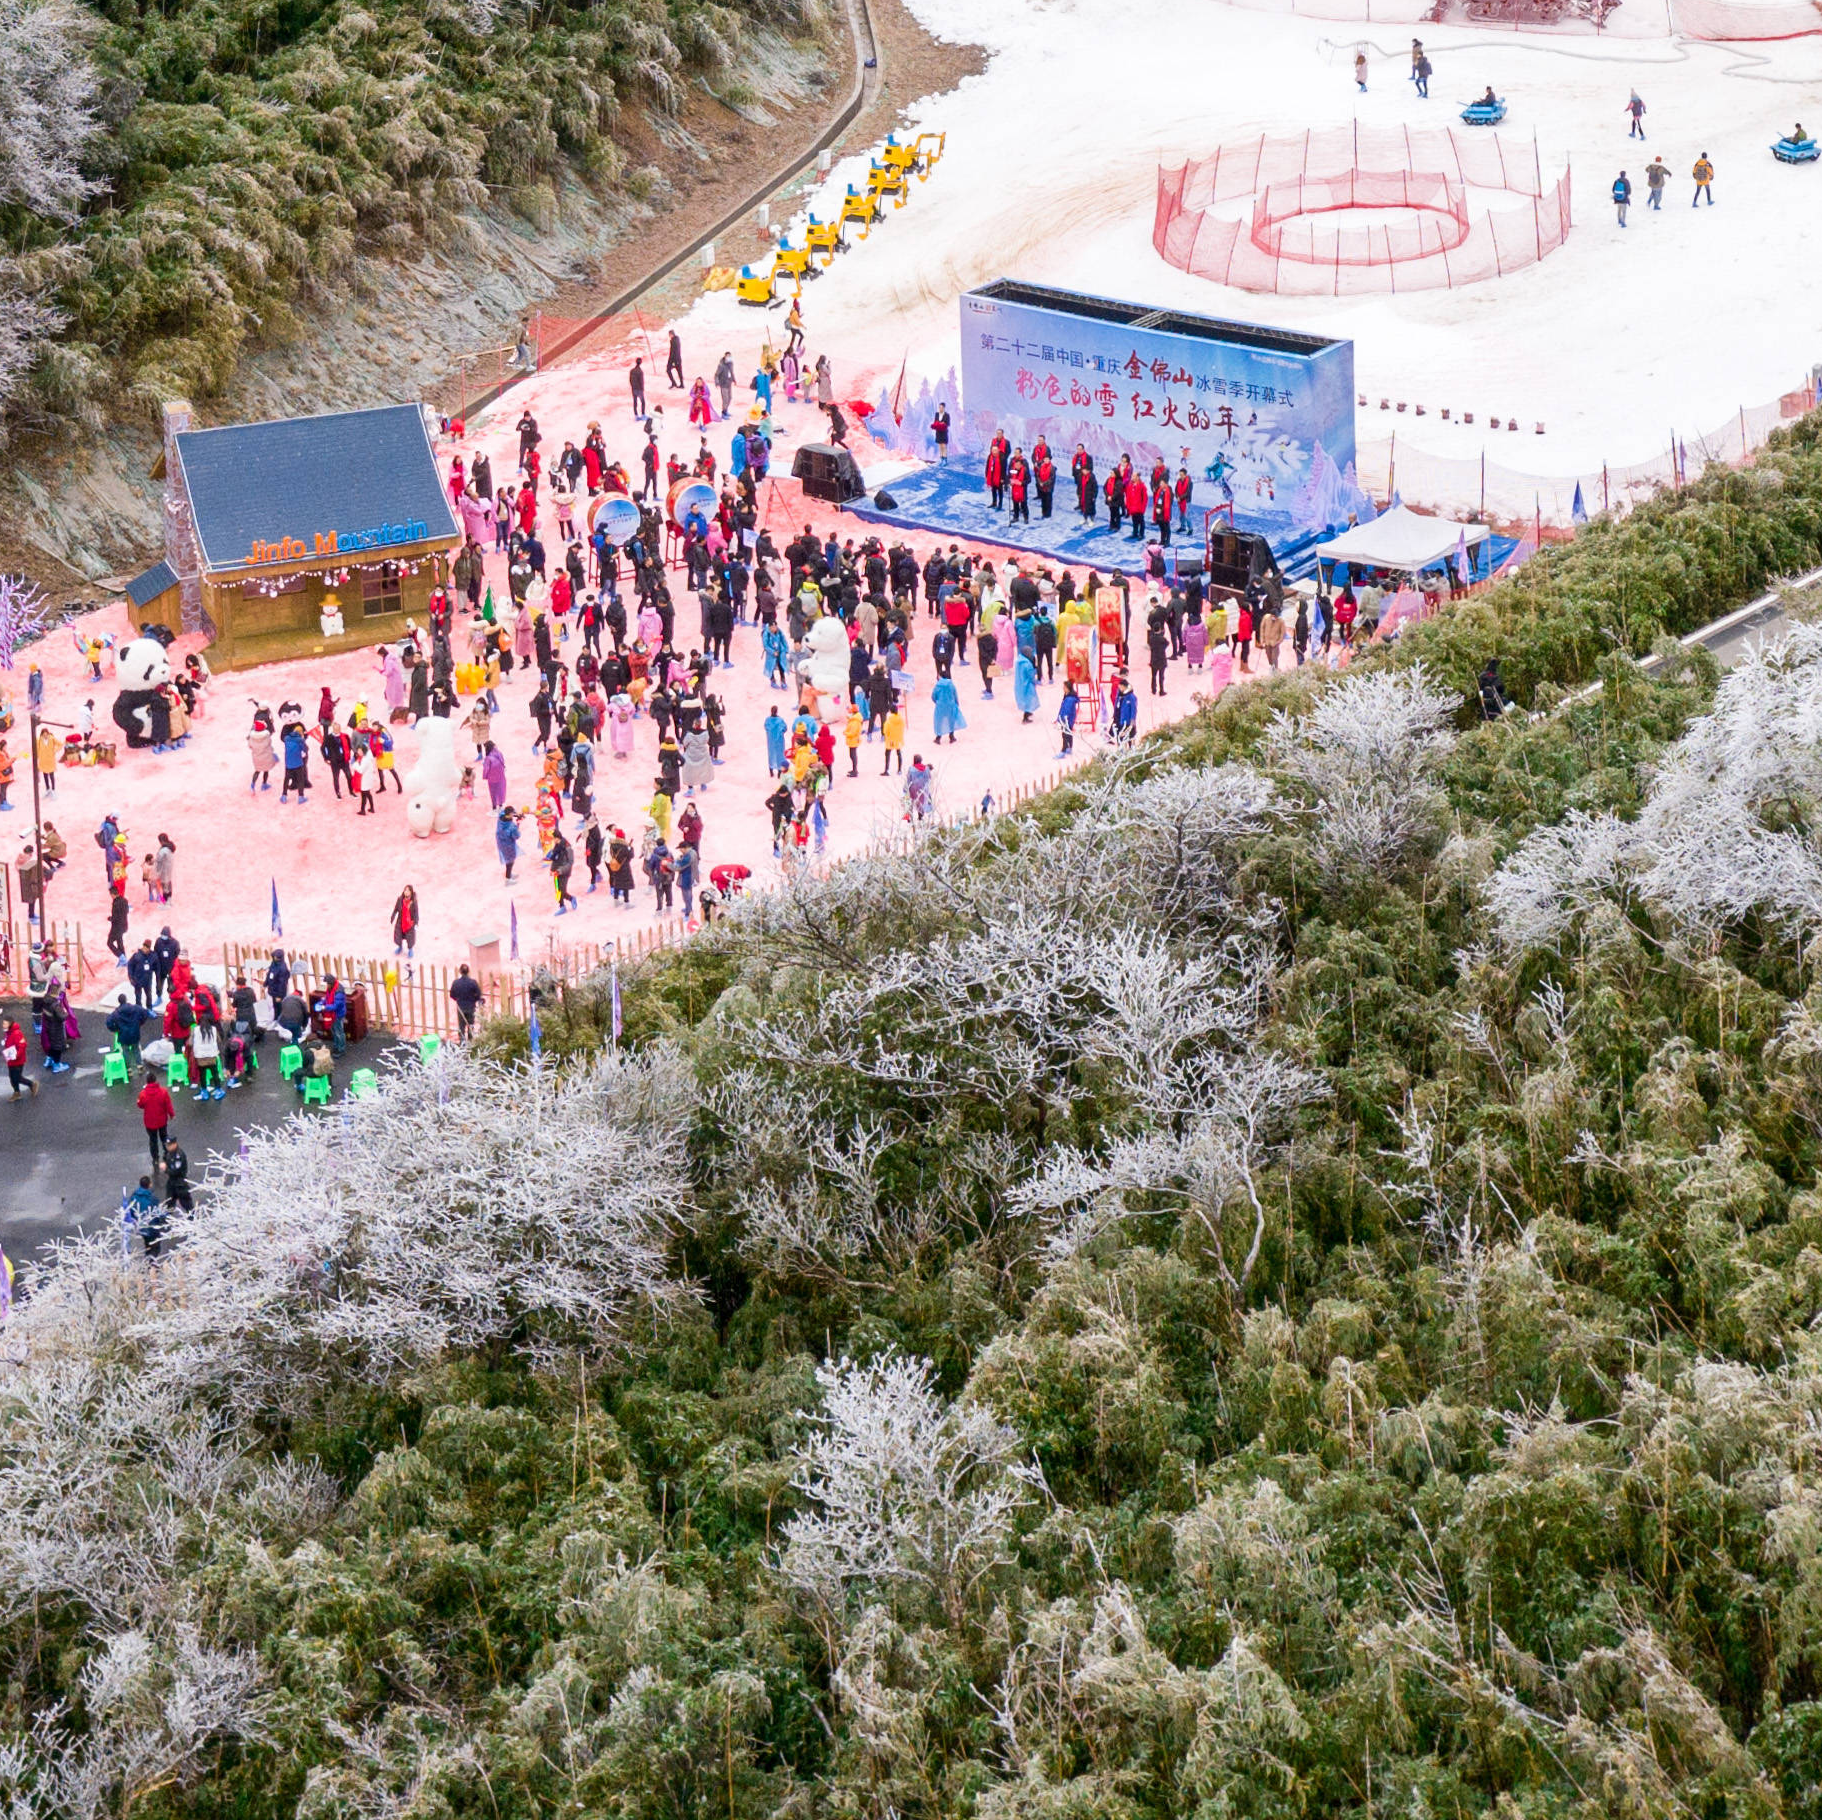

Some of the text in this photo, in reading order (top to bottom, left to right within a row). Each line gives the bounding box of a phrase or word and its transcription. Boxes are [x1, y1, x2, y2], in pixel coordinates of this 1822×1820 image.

[1015, 366, 1239, 441] 粉色的雪 红火的年
[245, 517, 428, 565] Jinfo Mountain
